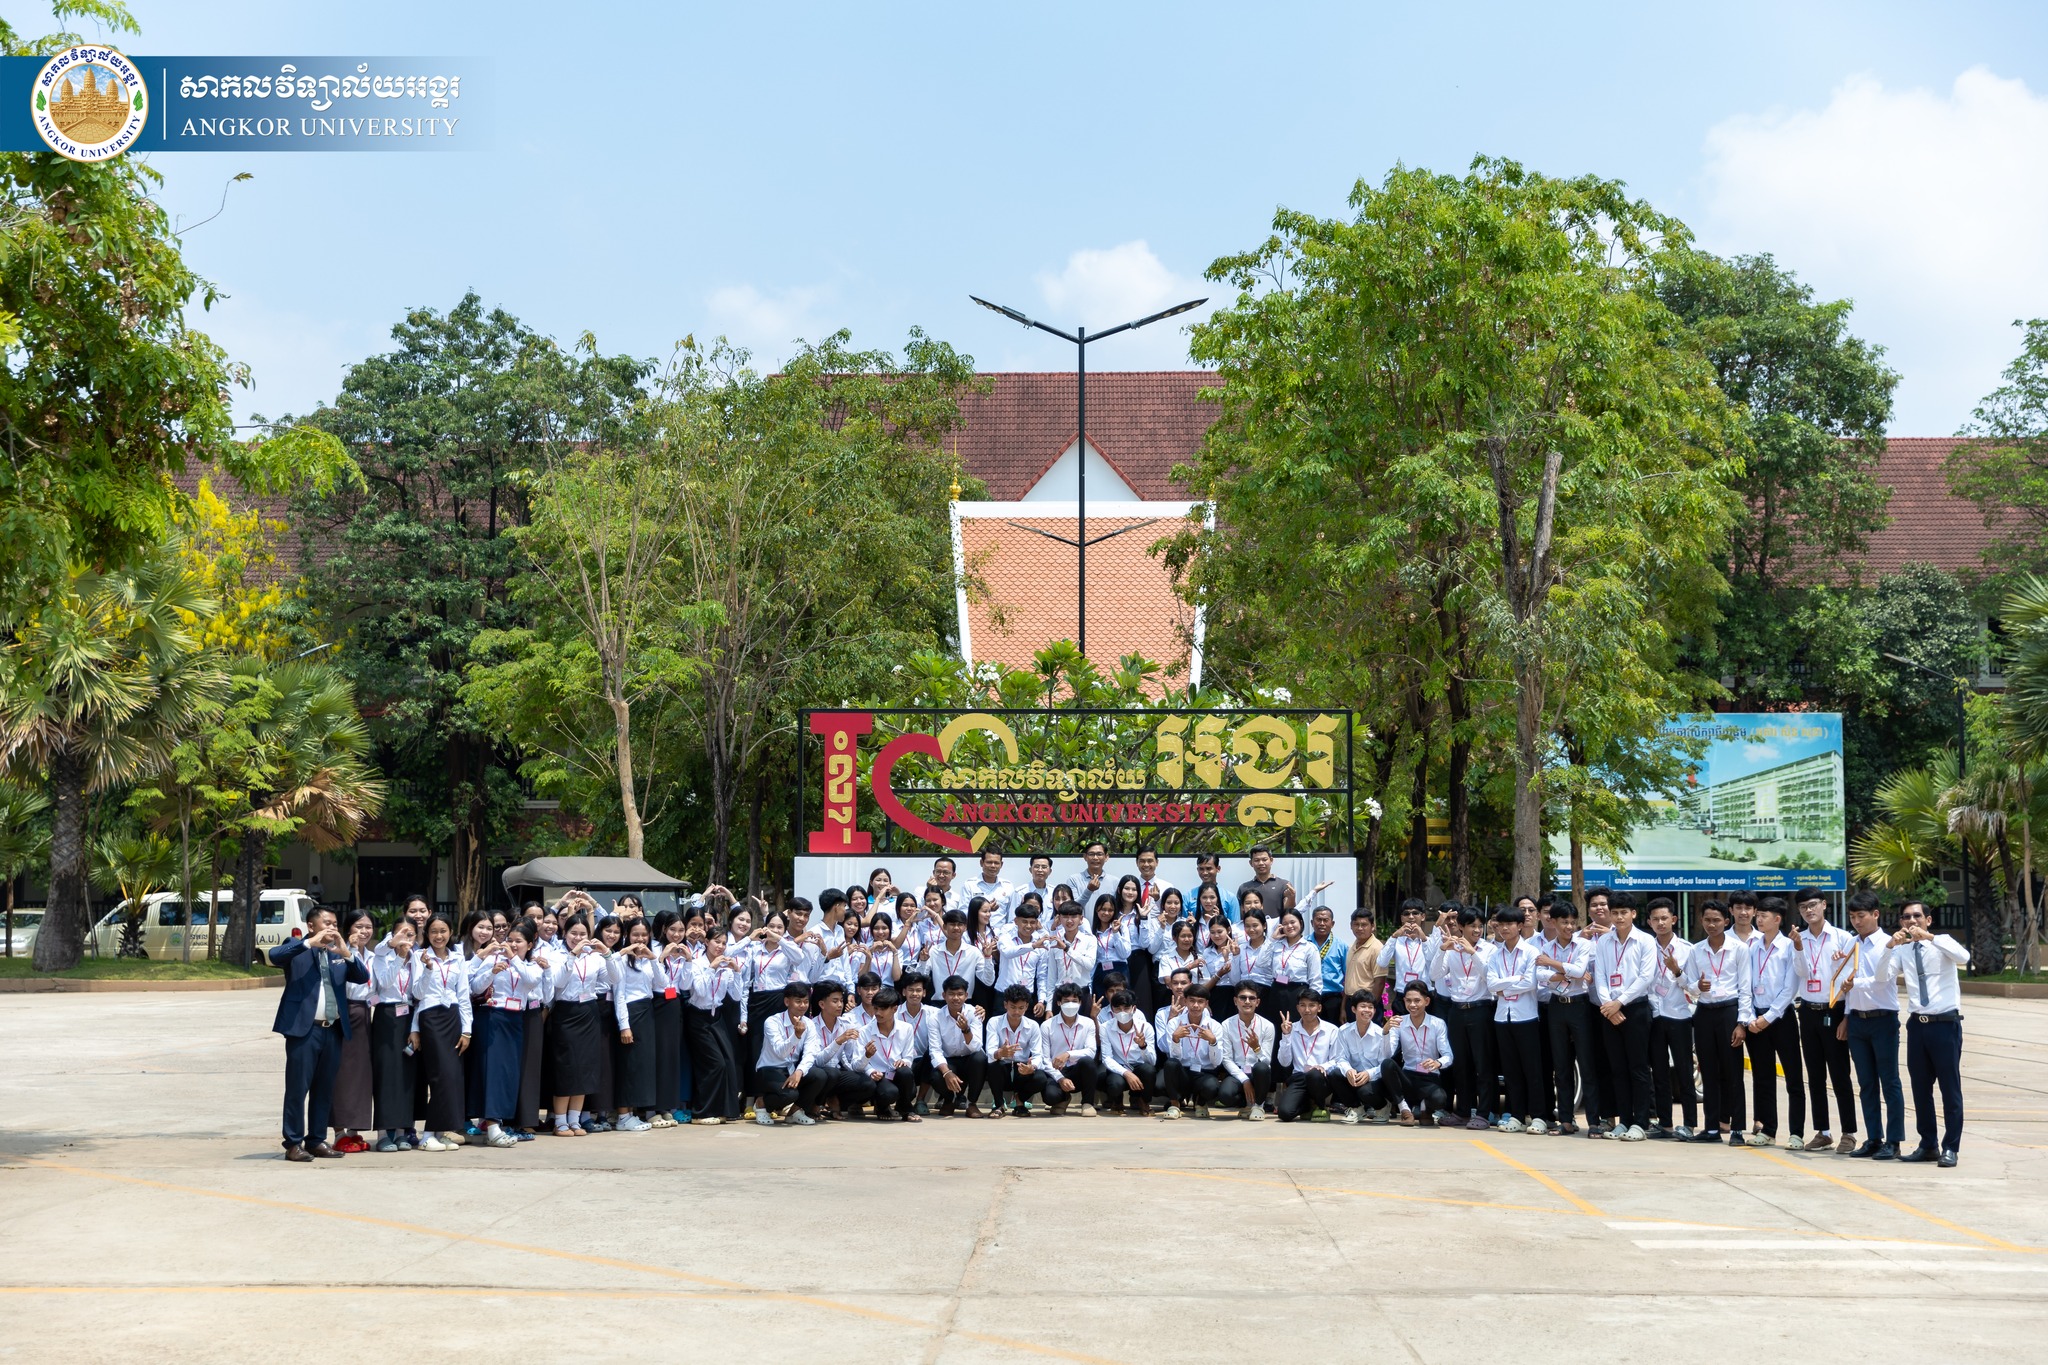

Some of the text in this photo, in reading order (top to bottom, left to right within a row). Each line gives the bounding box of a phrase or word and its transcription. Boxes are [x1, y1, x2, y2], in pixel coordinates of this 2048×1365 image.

[942, 803, 1231, 823] ANGKOR UNIVERSITY
[256, 933, 280, 945] (A.U.)
